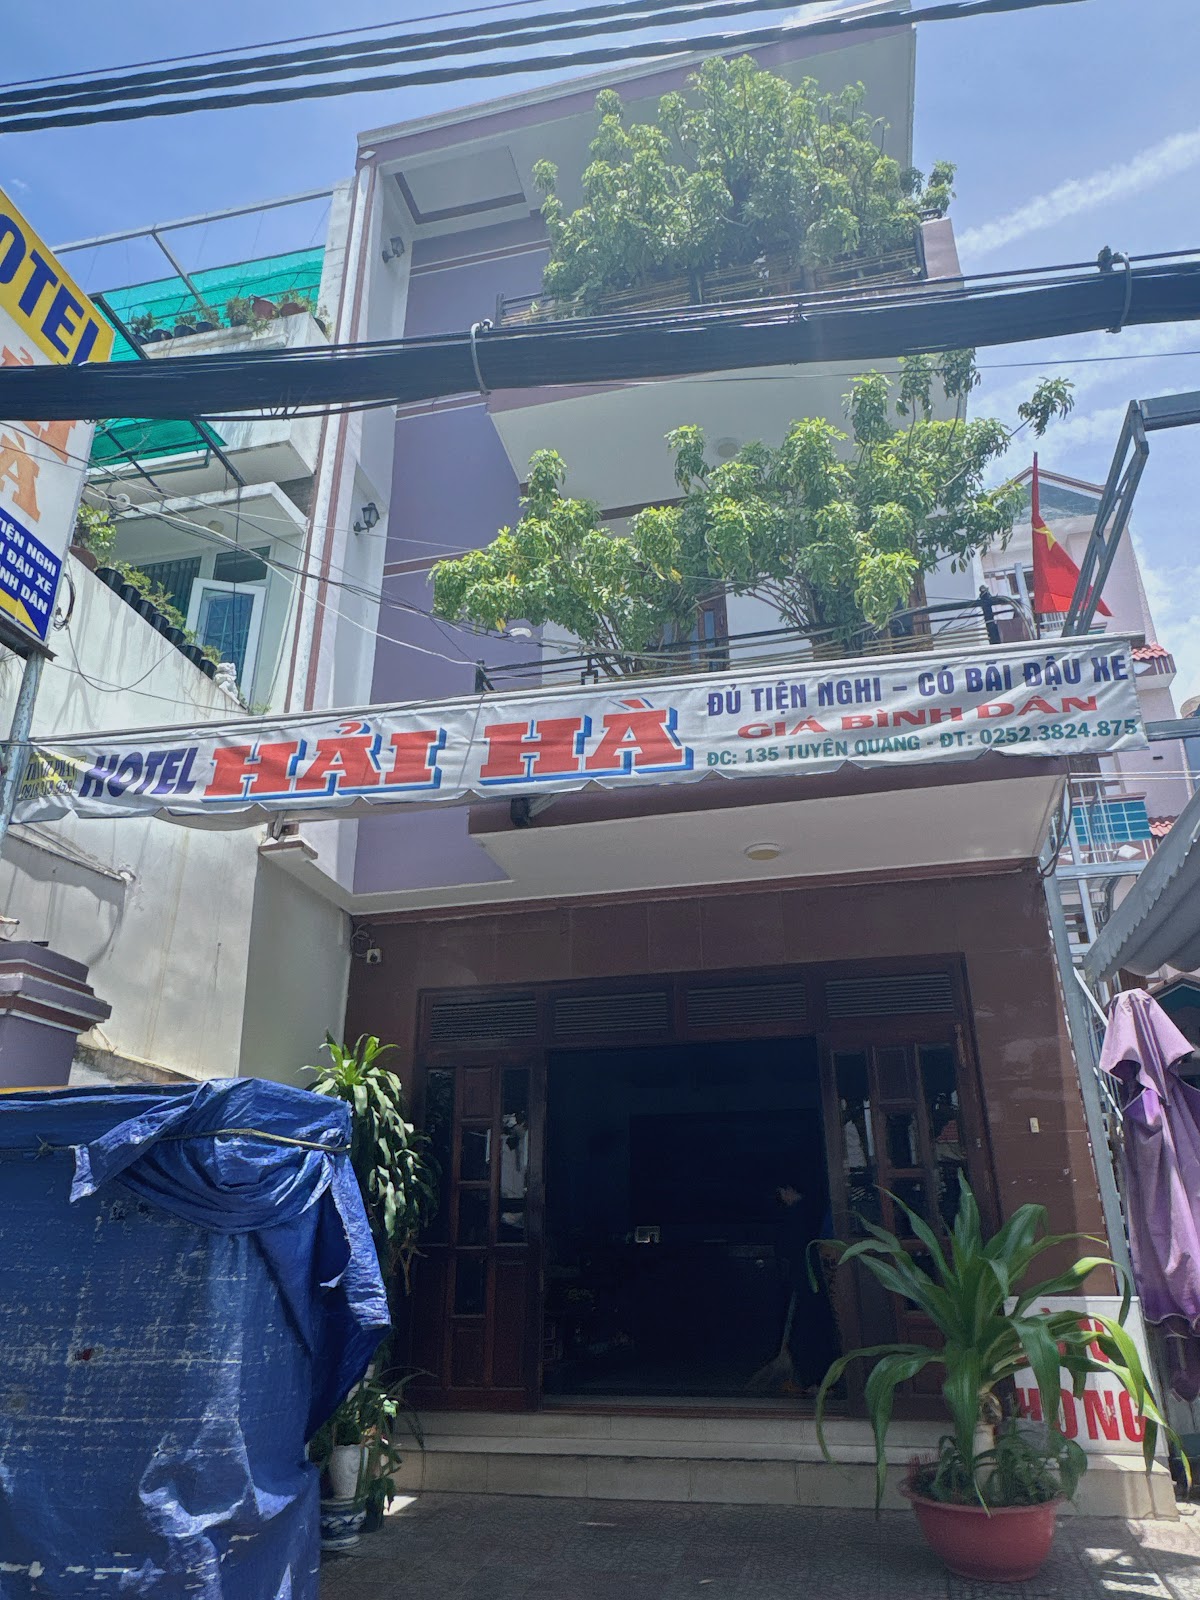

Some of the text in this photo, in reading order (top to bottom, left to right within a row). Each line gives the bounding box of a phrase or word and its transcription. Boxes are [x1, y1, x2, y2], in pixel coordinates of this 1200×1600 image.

[0, 516, 57, 578] IỆN NGHI
[6, 547, 35, 580] ĐẬU
[35, 572, 53, 597] XE
[20, 583, 49, 616] DÂN
[707, 684, 741, 717] ĐỦ
[751, 681, 807, 715] TIỆN
[817, 677, 882, 707] NGHI
[918, 664, 955, 697] CÓ
[965, 661, 1012, 693] BÃI
[1023, 656, 1082, 691] ĐẬU
[1091, 655, 1129, 683] XE
[738, 695, 1098, 739] GIÁ BÌNH DÂN
[78, 697, 694, 804] HOTEL HẢI HÀ
[707, 750, 737, 767] ĐC:
[745, 746, 780, 764] 135
[785, 738, 849, 761] TUYÊN
[855, 735, 921, 757] QUANG
[939, 730, 973, 748] ĐT:
[979, 718, 1138, 745] 0252.3824.875
